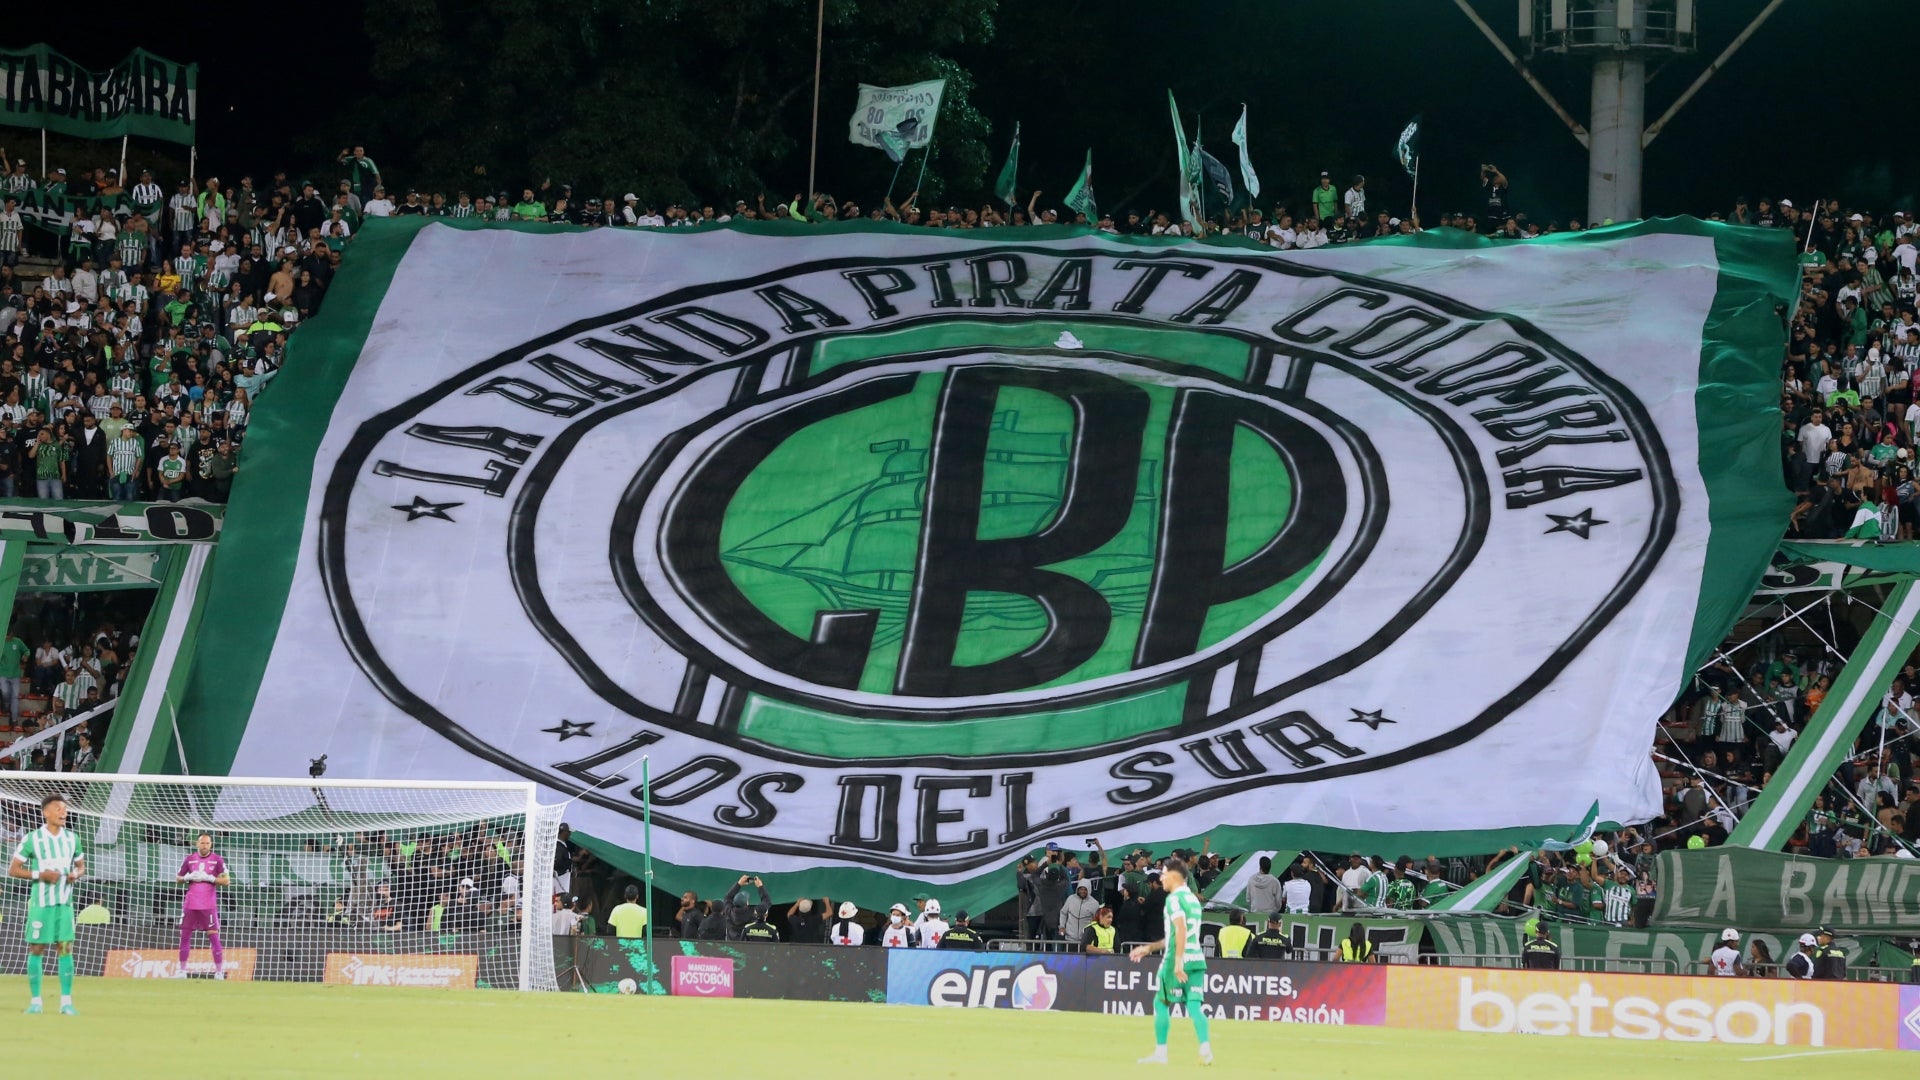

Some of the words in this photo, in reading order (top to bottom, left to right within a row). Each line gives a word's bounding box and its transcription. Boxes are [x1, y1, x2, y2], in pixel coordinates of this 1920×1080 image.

[373, 423, 543, 498] LA
[464, 284, 852, 418] BANDA
[841, 254, 1262, 325] PIRATA
[1272, 288, 1643, 509] COLOMBIA
[551, 729, 805, 828] LOS
[829, 771, 1071, 857] DEL
[1106, 711, 1366, 805] SUR
[1668, 851, 1737, 921] LA
[680, 970, 730, 988] POSTOBÓN
[929, 968, 1012, 1008] elf
[1104, 970, 1141, 990] ELF
[1147, 971, 1299, 999] LICANTES,
[1268, 1003, 1345, 1025] PASIÓN
[1458, 976, 1826, 1047] betsson
